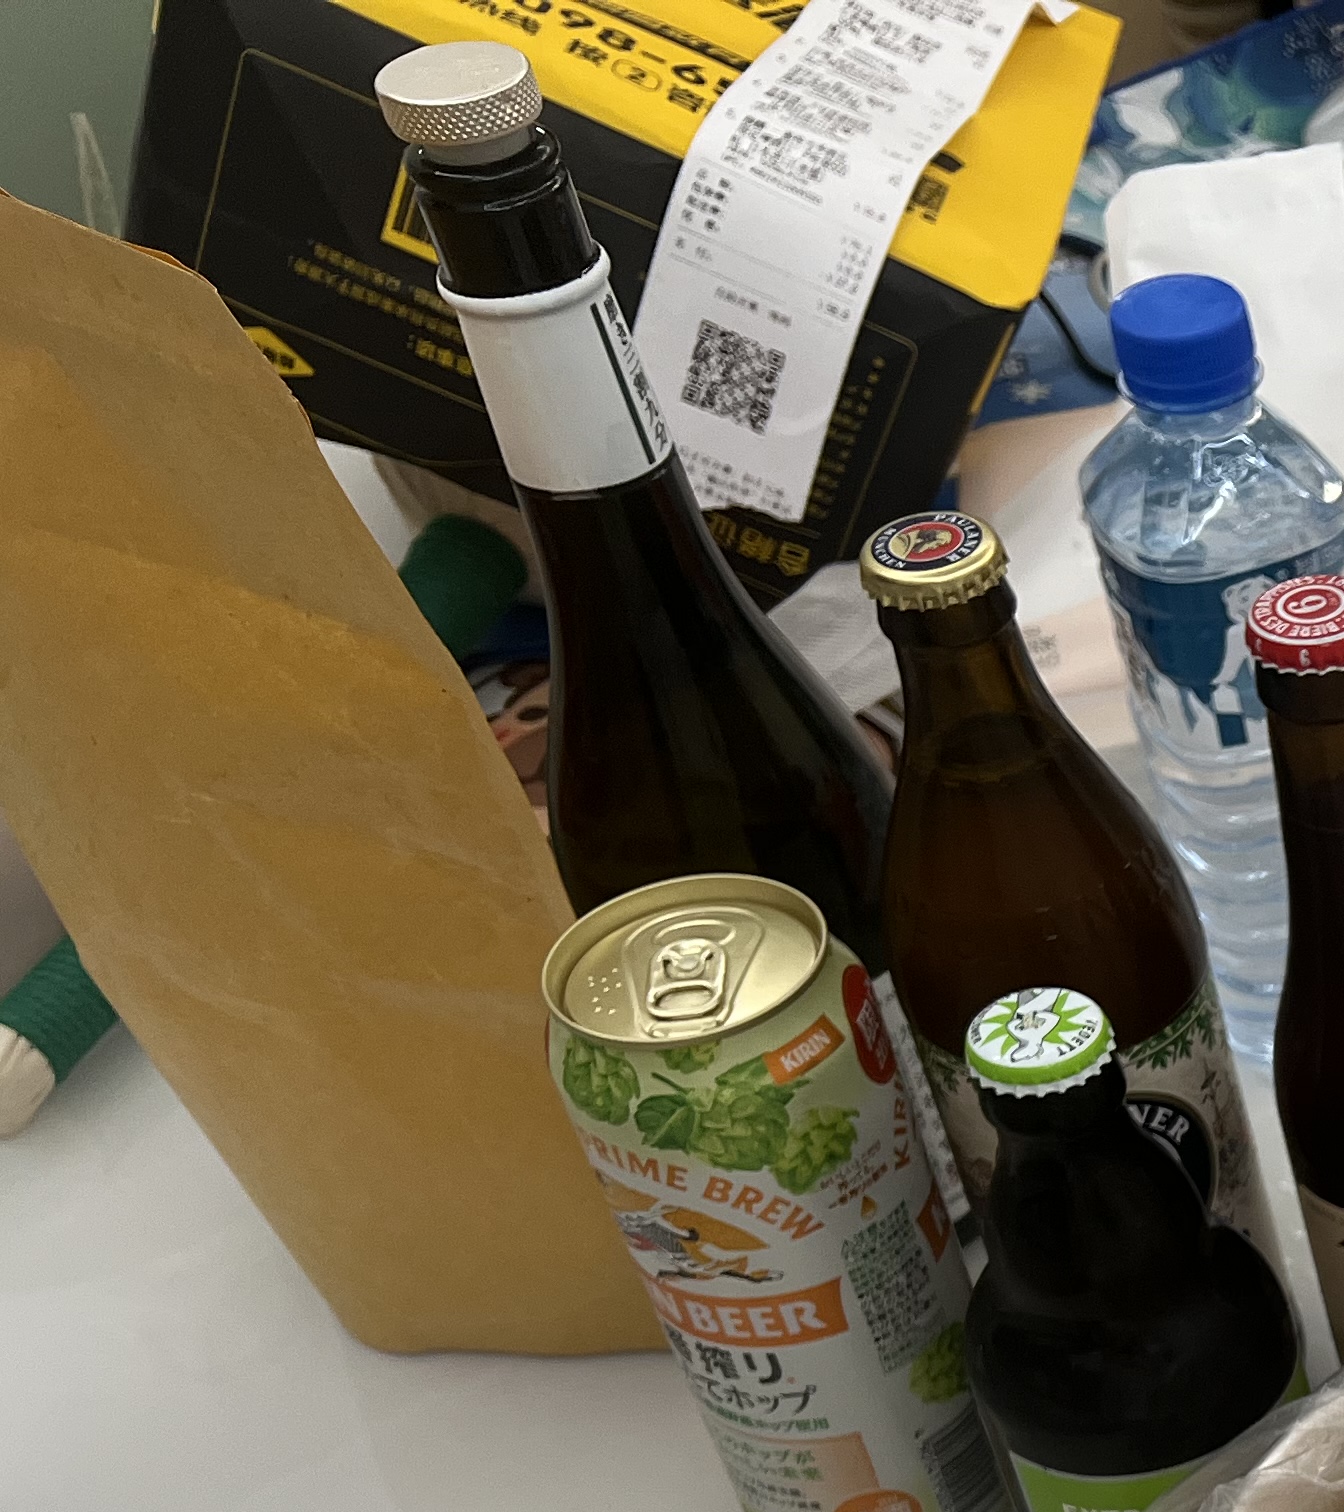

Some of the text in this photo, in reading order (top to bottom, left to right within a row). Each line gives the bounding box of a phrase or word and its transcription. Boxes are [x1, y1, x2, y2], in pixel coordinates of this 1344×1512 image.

[779, 1029, 832, 1073] KIRIN
[702, 1174, 825, 1241] BREW
[690, 1299, 827, 1339] BEER
